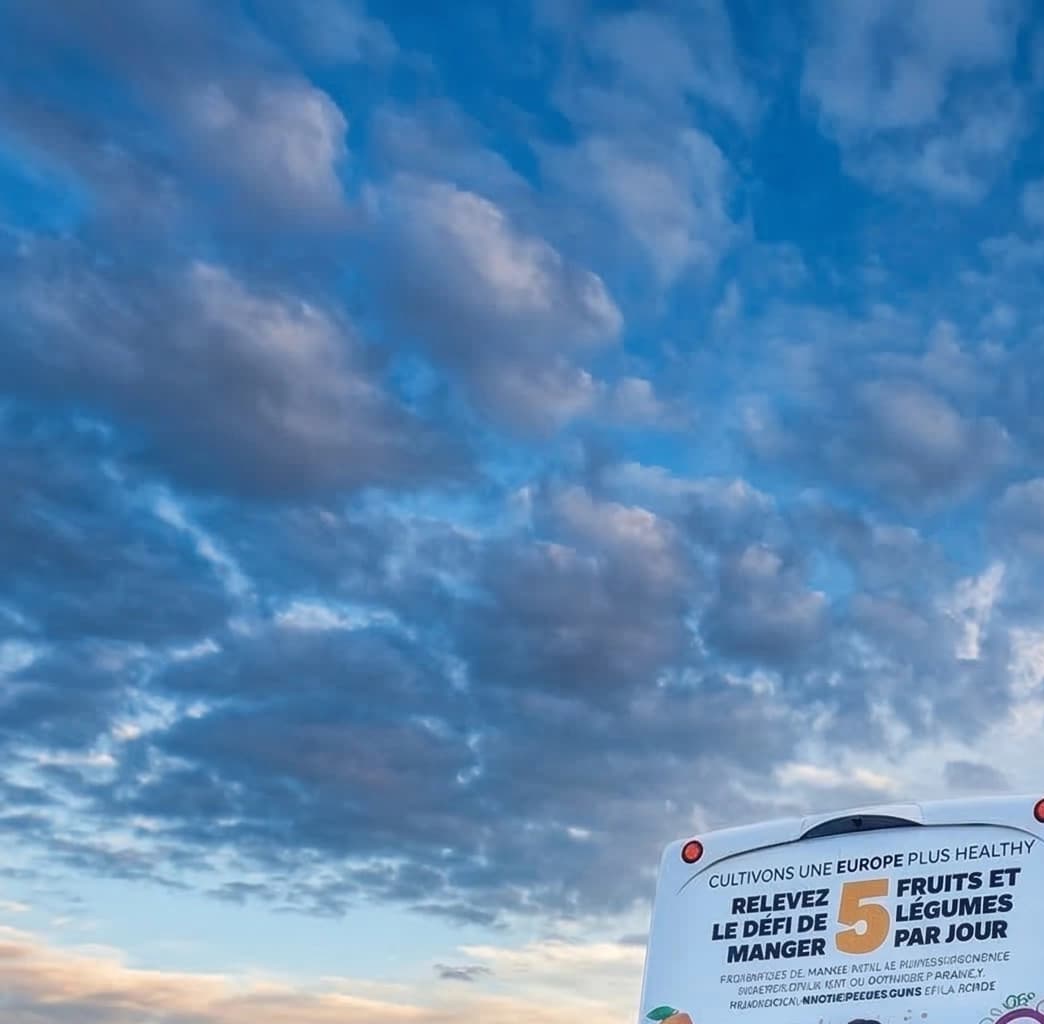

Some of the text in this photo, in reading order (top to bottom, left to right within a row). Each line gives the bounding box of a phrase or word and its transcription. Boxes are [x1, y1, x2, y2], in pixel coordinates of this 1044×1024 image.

[709, 839, 1036, 888] CULTIVONS UNE EUROPE PLUS HEALTHY
[896, 867, 1021, 897] FRUITS ET
[731, 888, 830, 915] RELEVEZ
[895, 894, 1013, 922] LÉGUMES
[712, 913, 828, 940] LE DÉFI DE
[835, 878, 891, 955] 5
[894, 920, 1008, 948] PAR JOUR
[727, 938, 826, 963] MANGER
